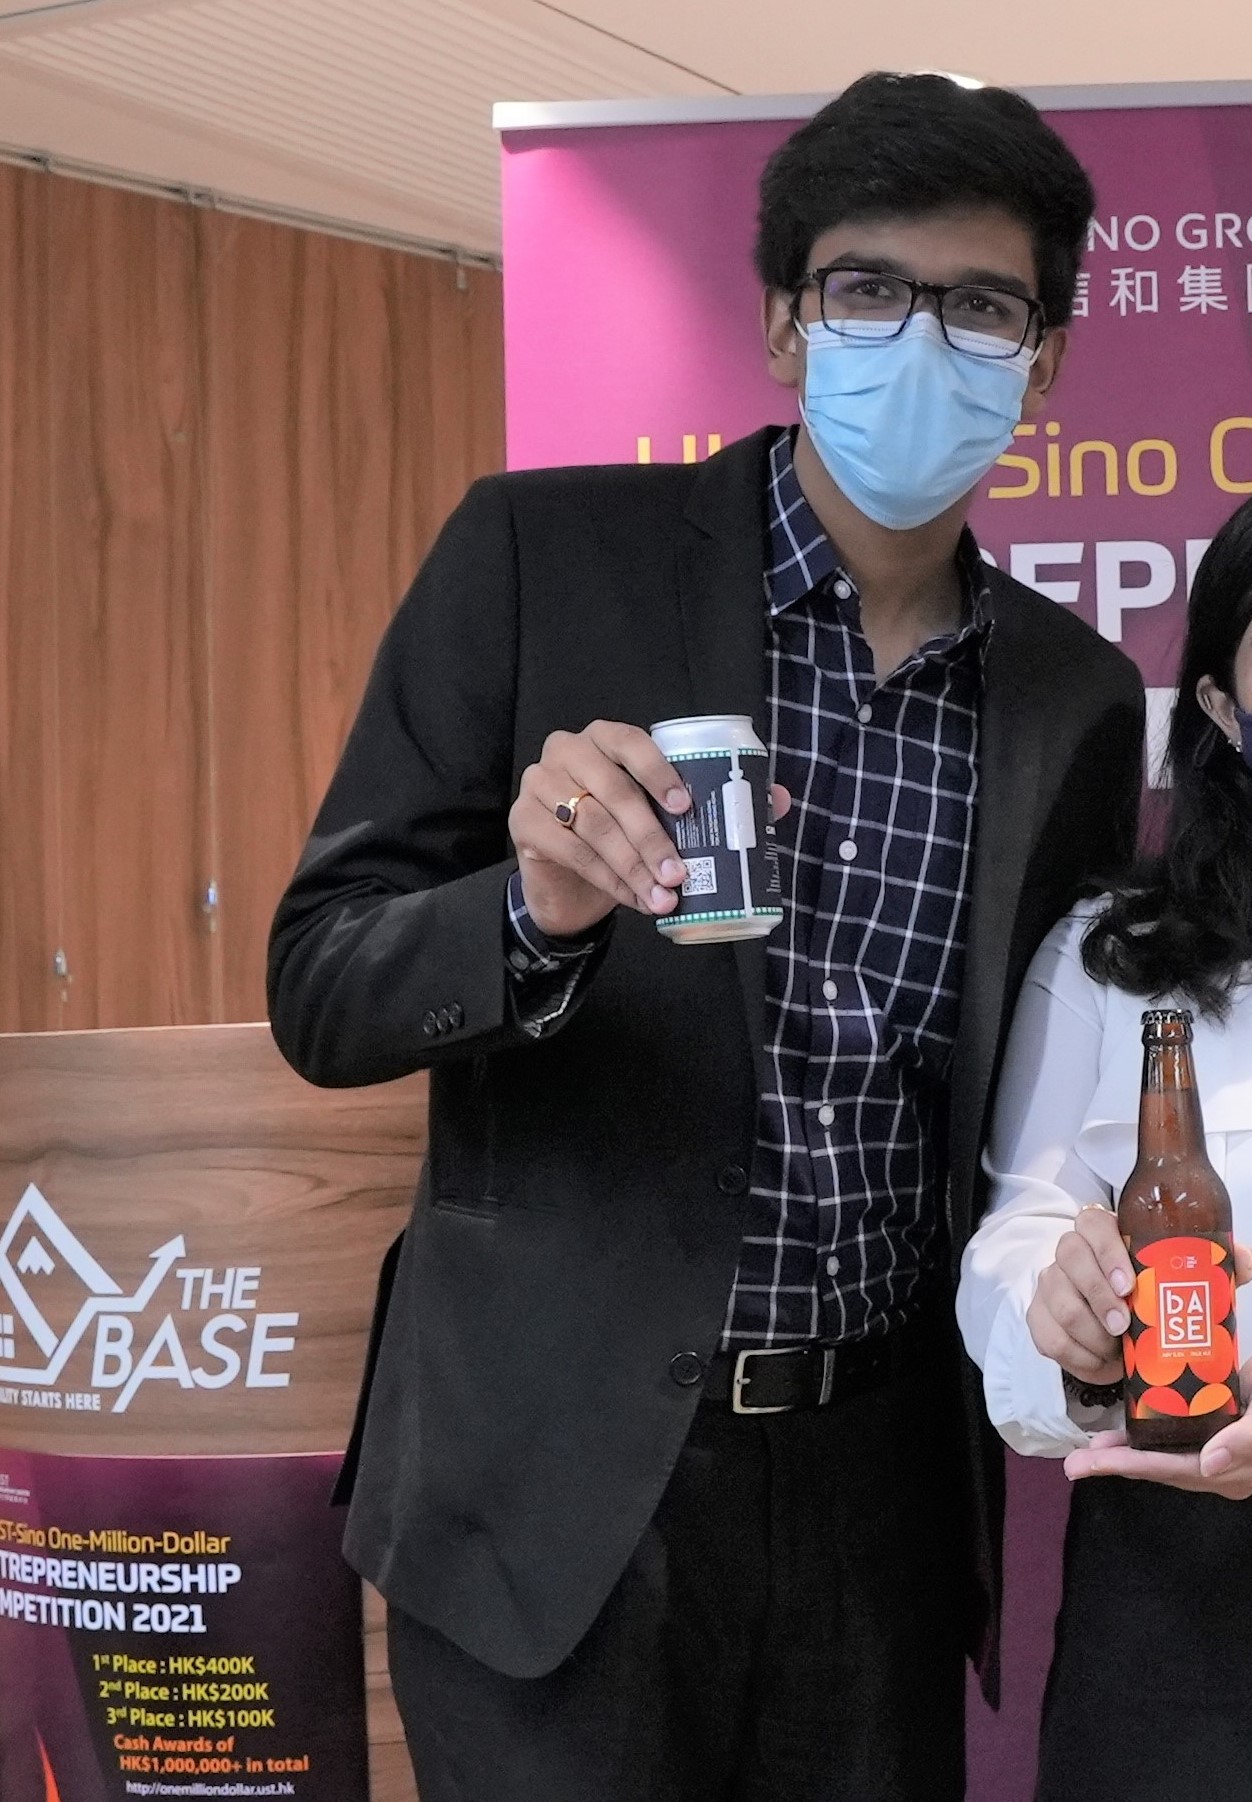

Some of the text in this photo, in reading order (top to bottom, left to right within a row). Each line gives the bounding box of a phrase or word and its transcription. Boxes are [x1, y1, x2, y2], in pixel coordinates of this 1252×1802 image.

[1086, 215, 1161, 252] NO
[987, 421, 1178, 499] Sino
[176, 1266, 262, 1310] THE
[91, 1311, 299, 1413] BASE
[21, 1390, 62, 1409] STARTS
[65, 1393, 101, 1411] HERE
[0, 1518, 231, 1554] ST-Sino One-Million-Dollar
[0, 1549, 242, 1594] TREPRENEURSHIP
[0, 1588, 207, 1634] MPETITION 2021
[112, 1655, 157, 1674] Place
[168, 1656, 255, 1676] HK$400K
[100, 1680, 122, 1698] 2nd
[125, 1681, 170, 1700] Place
[182, 1682, 269, 1702] HK$200K
[106, 1707, 127, 1725] 3rd
[130, 1708, 176, 1727] Place
[188, 1709, 275, 1729] HK$100K
[113, 1734, 235, 1752] Cash Awards of
[119, 1755, 310, 1775] HK$1,000,000+ in total
[125, 1780, 295, 1796] http://onemilliondollar.ust.hk
